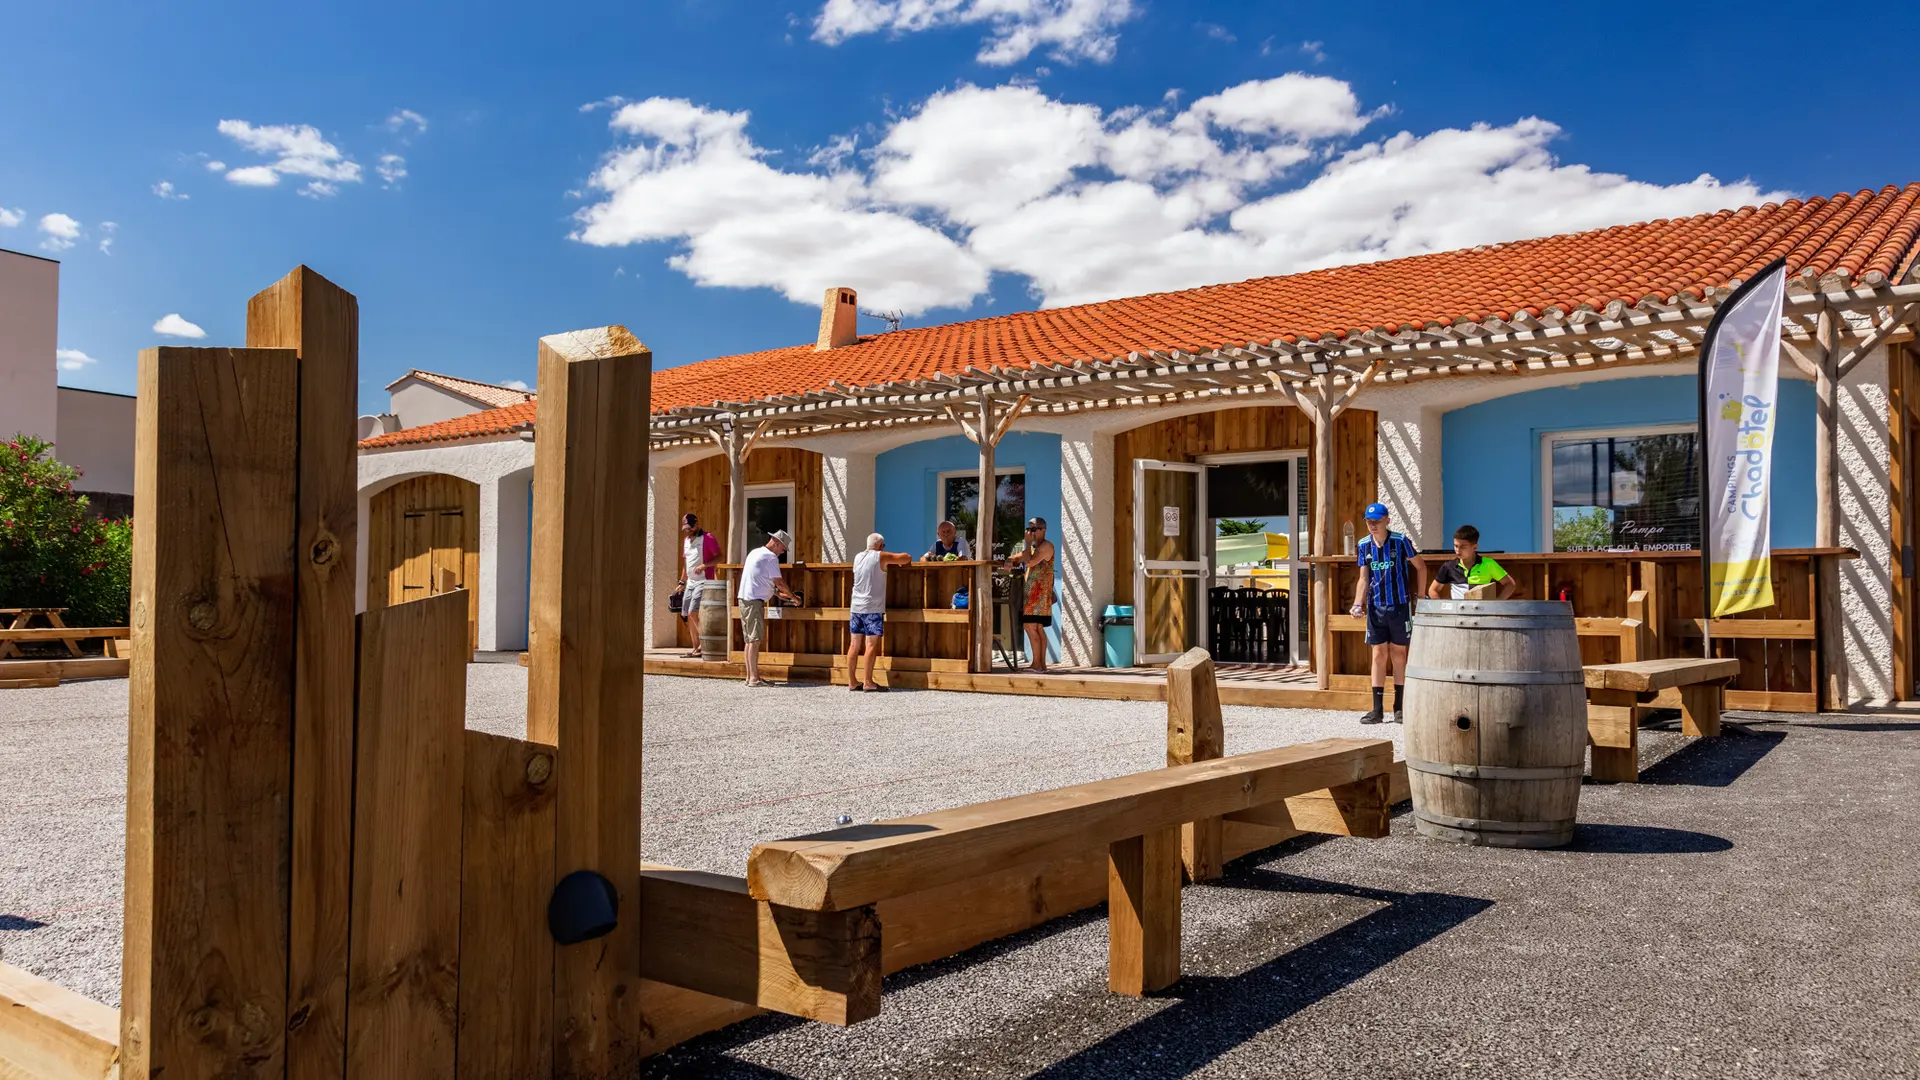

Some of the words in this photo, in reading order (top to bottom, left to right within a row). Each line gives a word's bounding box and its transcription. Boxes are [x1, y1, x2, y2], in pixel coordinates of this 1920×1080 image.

[1736, 395, 1771, 520] Chadotel
[1727, 455, 1737, 513] CAMPINGS
[1620, 520, 1664, 538] Pampa
[1586, 544, 1614, 552] PLACE
[1643, 543, 1692, 552] EMPORTER
[992, 553, 1005, 561] BAR
